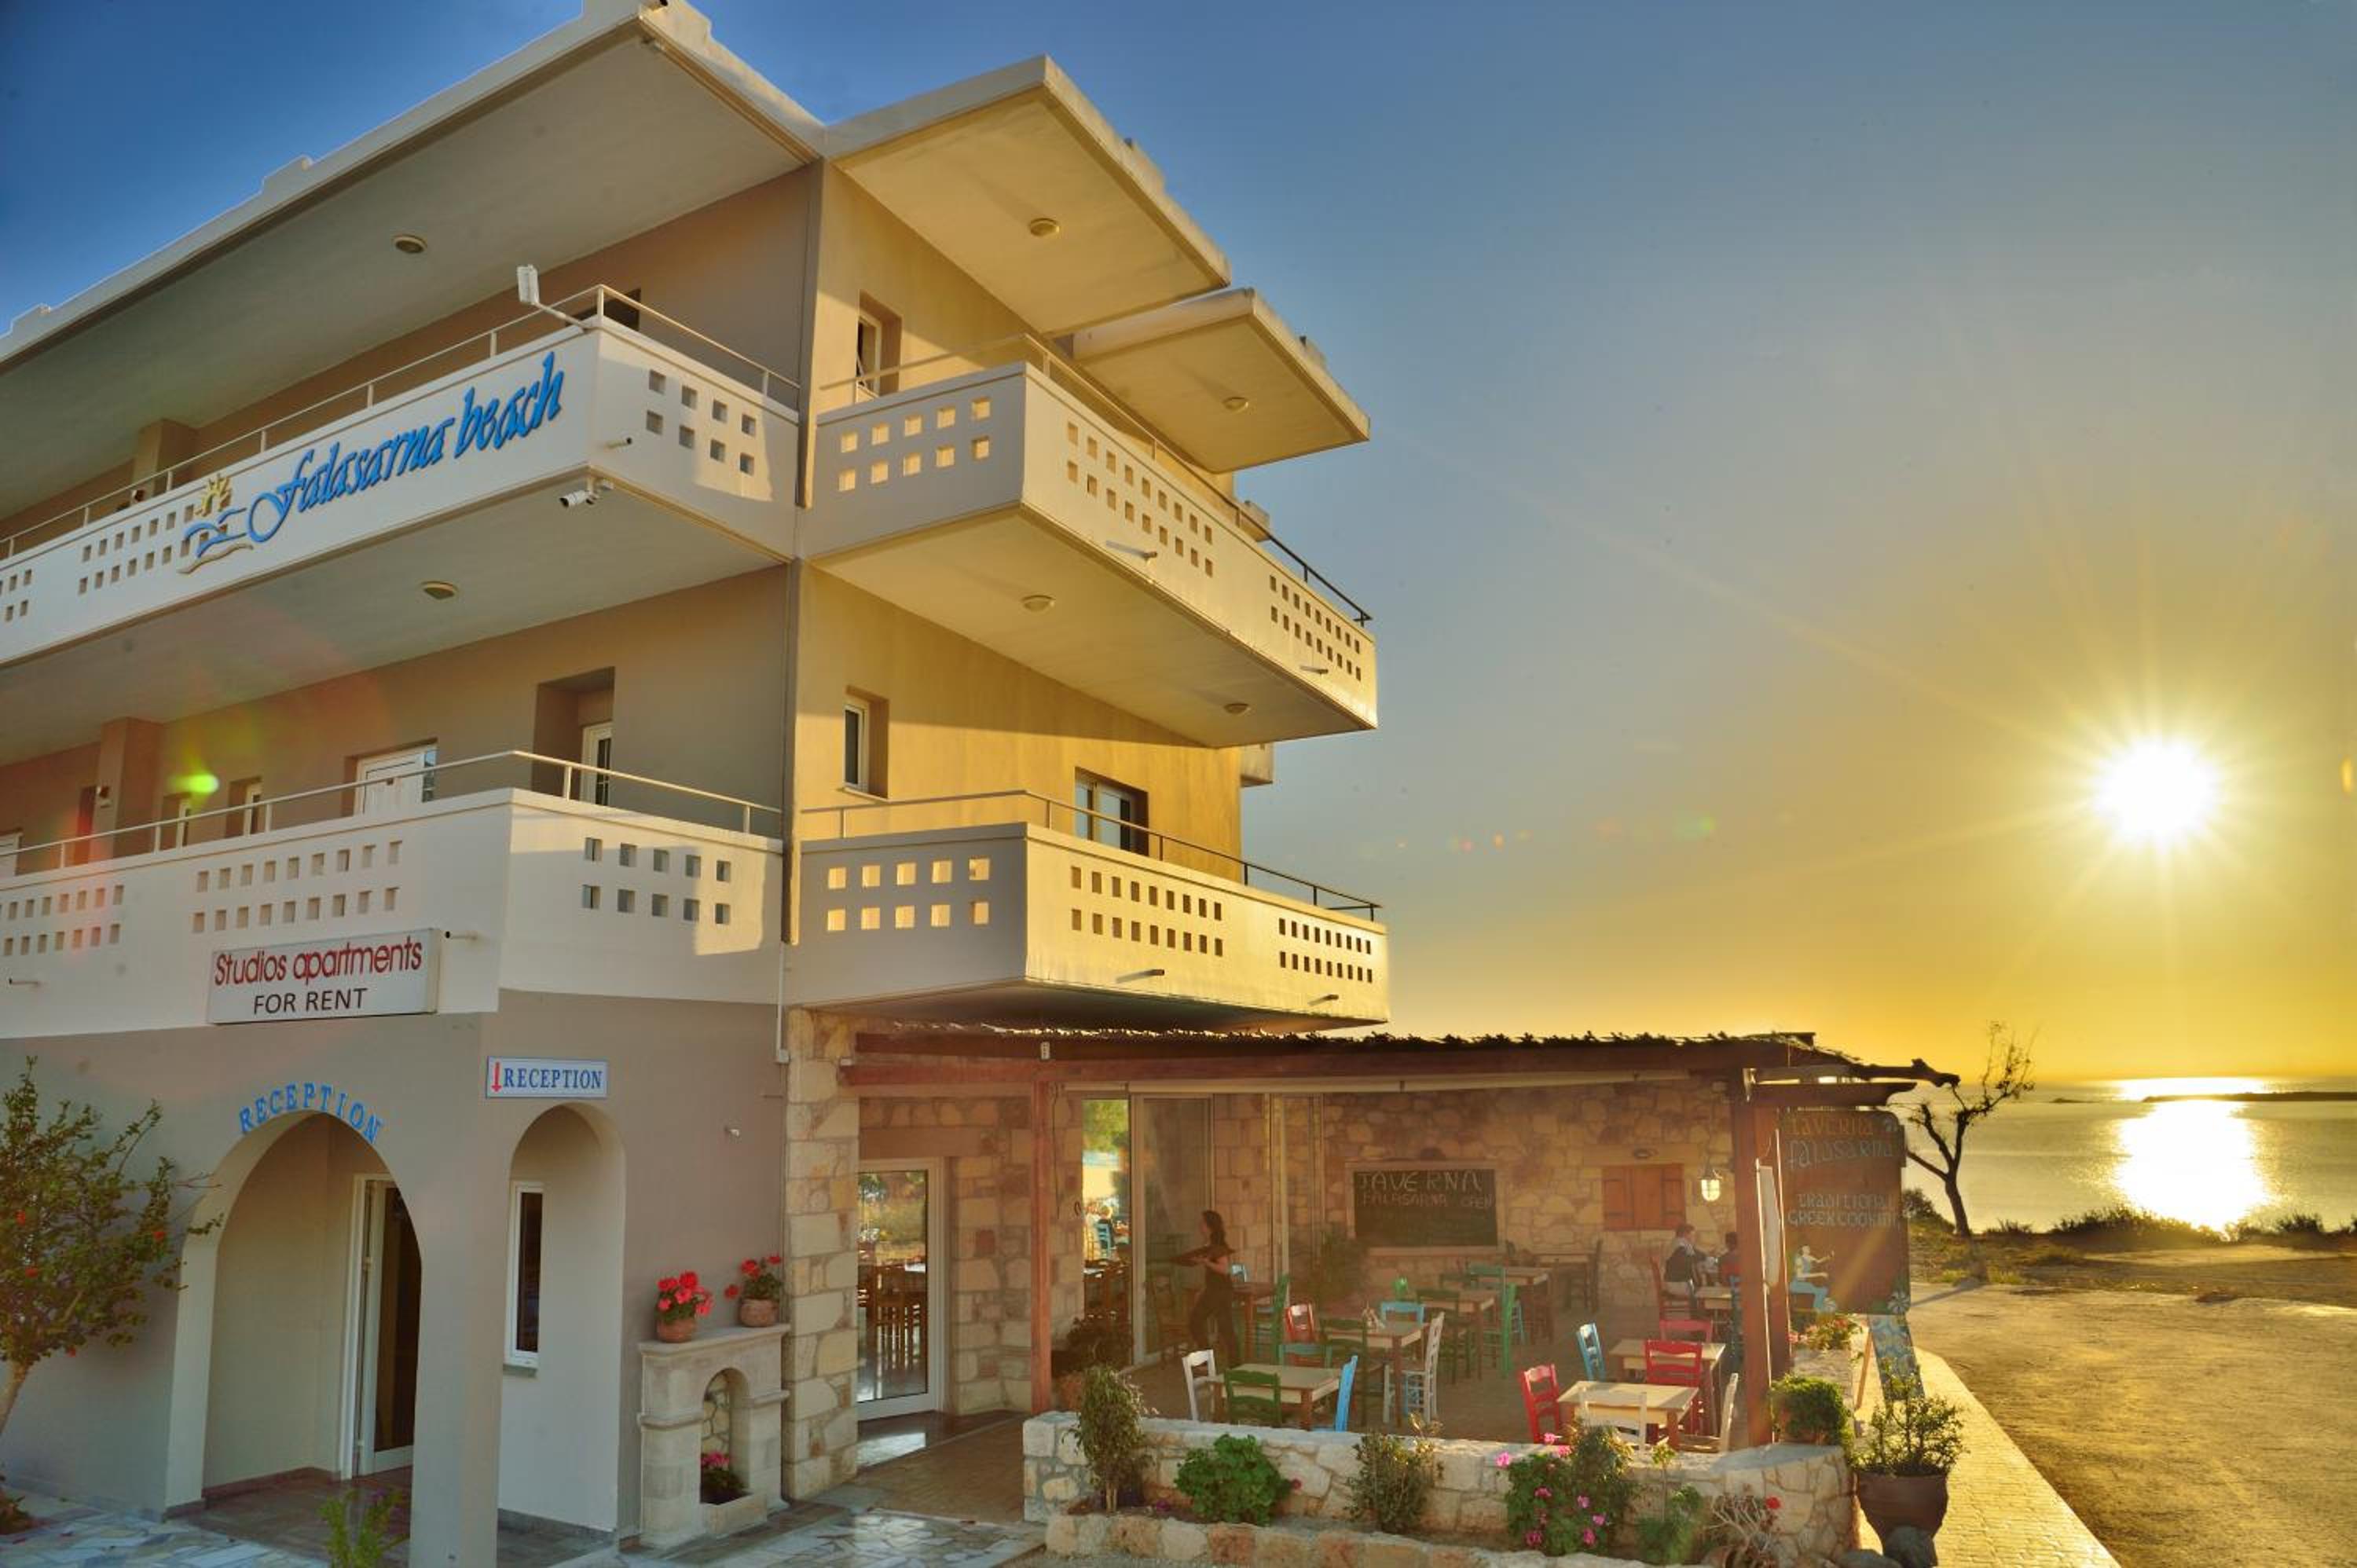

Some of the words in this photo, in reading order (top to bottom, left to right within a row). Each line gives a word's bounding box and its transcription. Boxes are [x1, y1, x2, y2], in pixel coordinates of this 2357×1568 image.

[453, 350, 566, 459] beach
[214, 948, 287, 987] Studios
[292, 935, 423, 987] apartments
[253, 993, 296, 1016] FOR
[305, 987, 368, 1012] RENT
[503, 1066, 603, 1090] RECEPTION
[238, 1081, 385, 1145] RECEPTION
